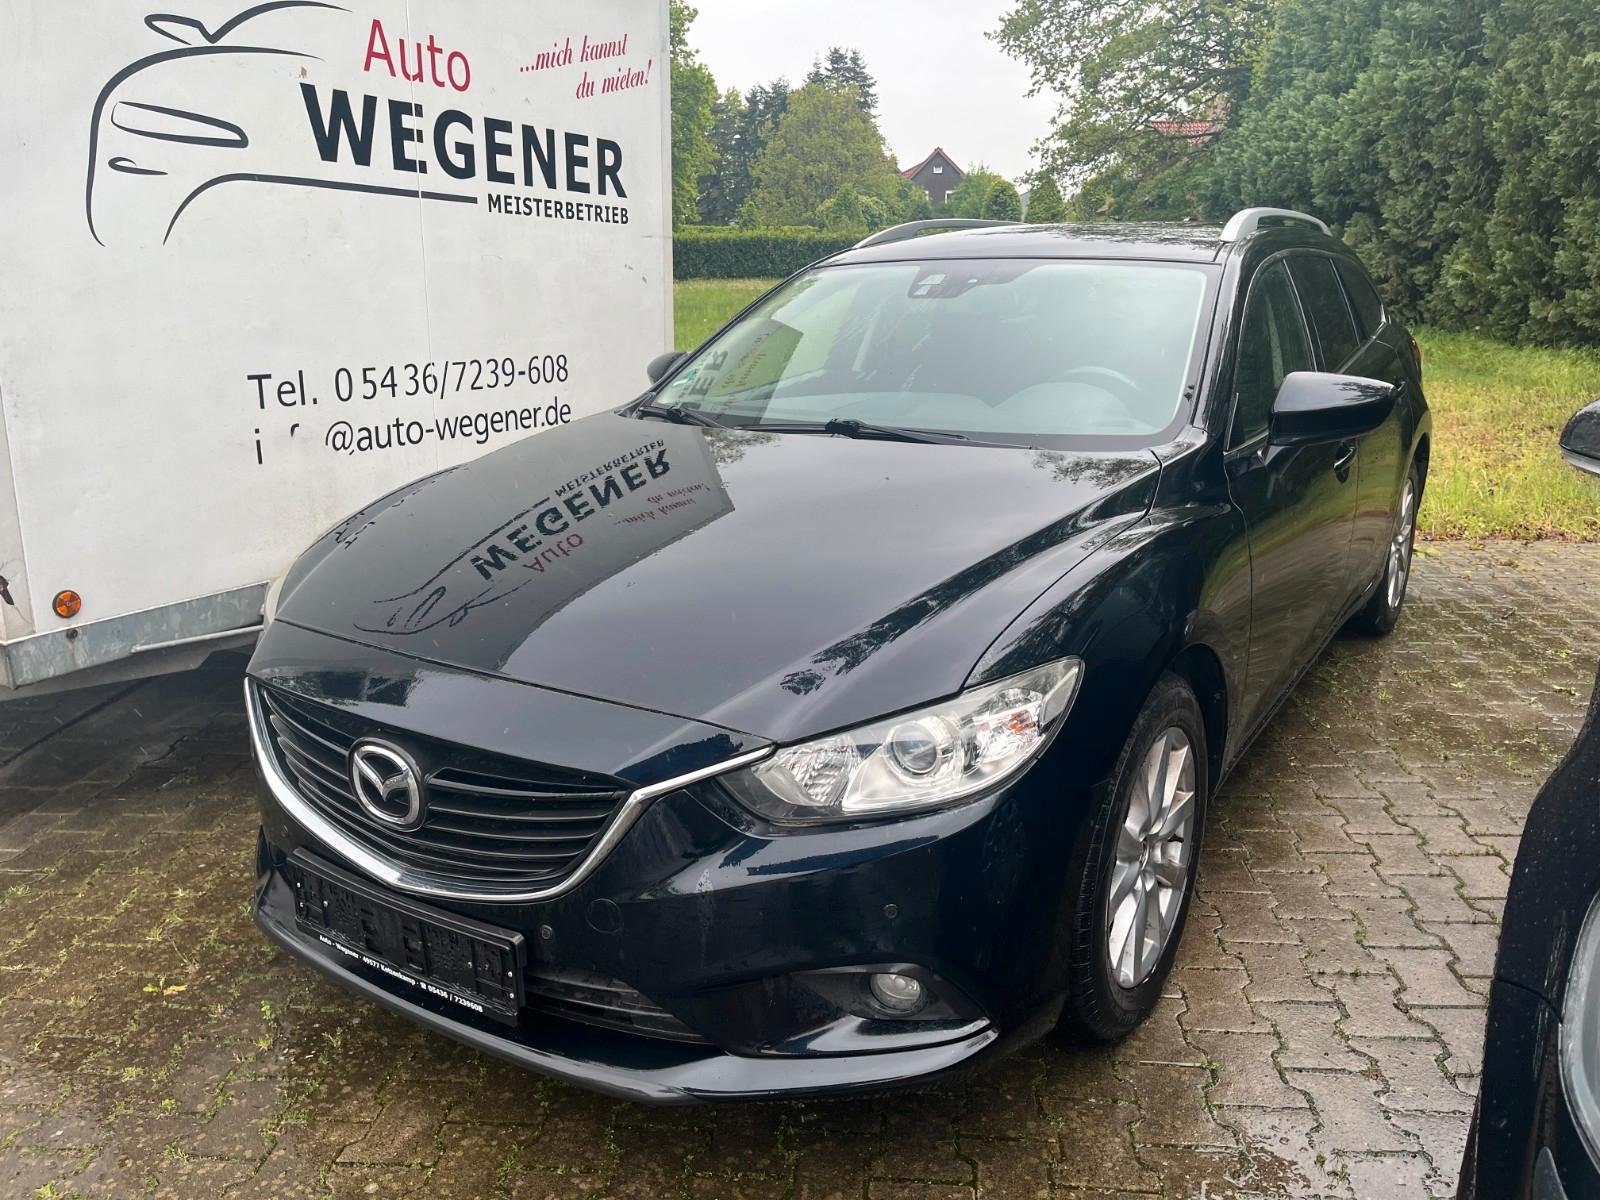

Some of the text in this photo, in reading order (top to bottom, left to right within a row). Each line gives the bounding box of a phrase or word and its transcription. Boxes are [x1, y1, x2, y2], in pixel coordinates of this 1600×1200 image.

[363, 18, 471, 92] Auto
[575, 72, 595, 100] du
[299, 82, 628, 198] WEGENER
[487, 193, 629, 225] MEISTERBETRIEB
[247, 370, 318, 409] Tel.
